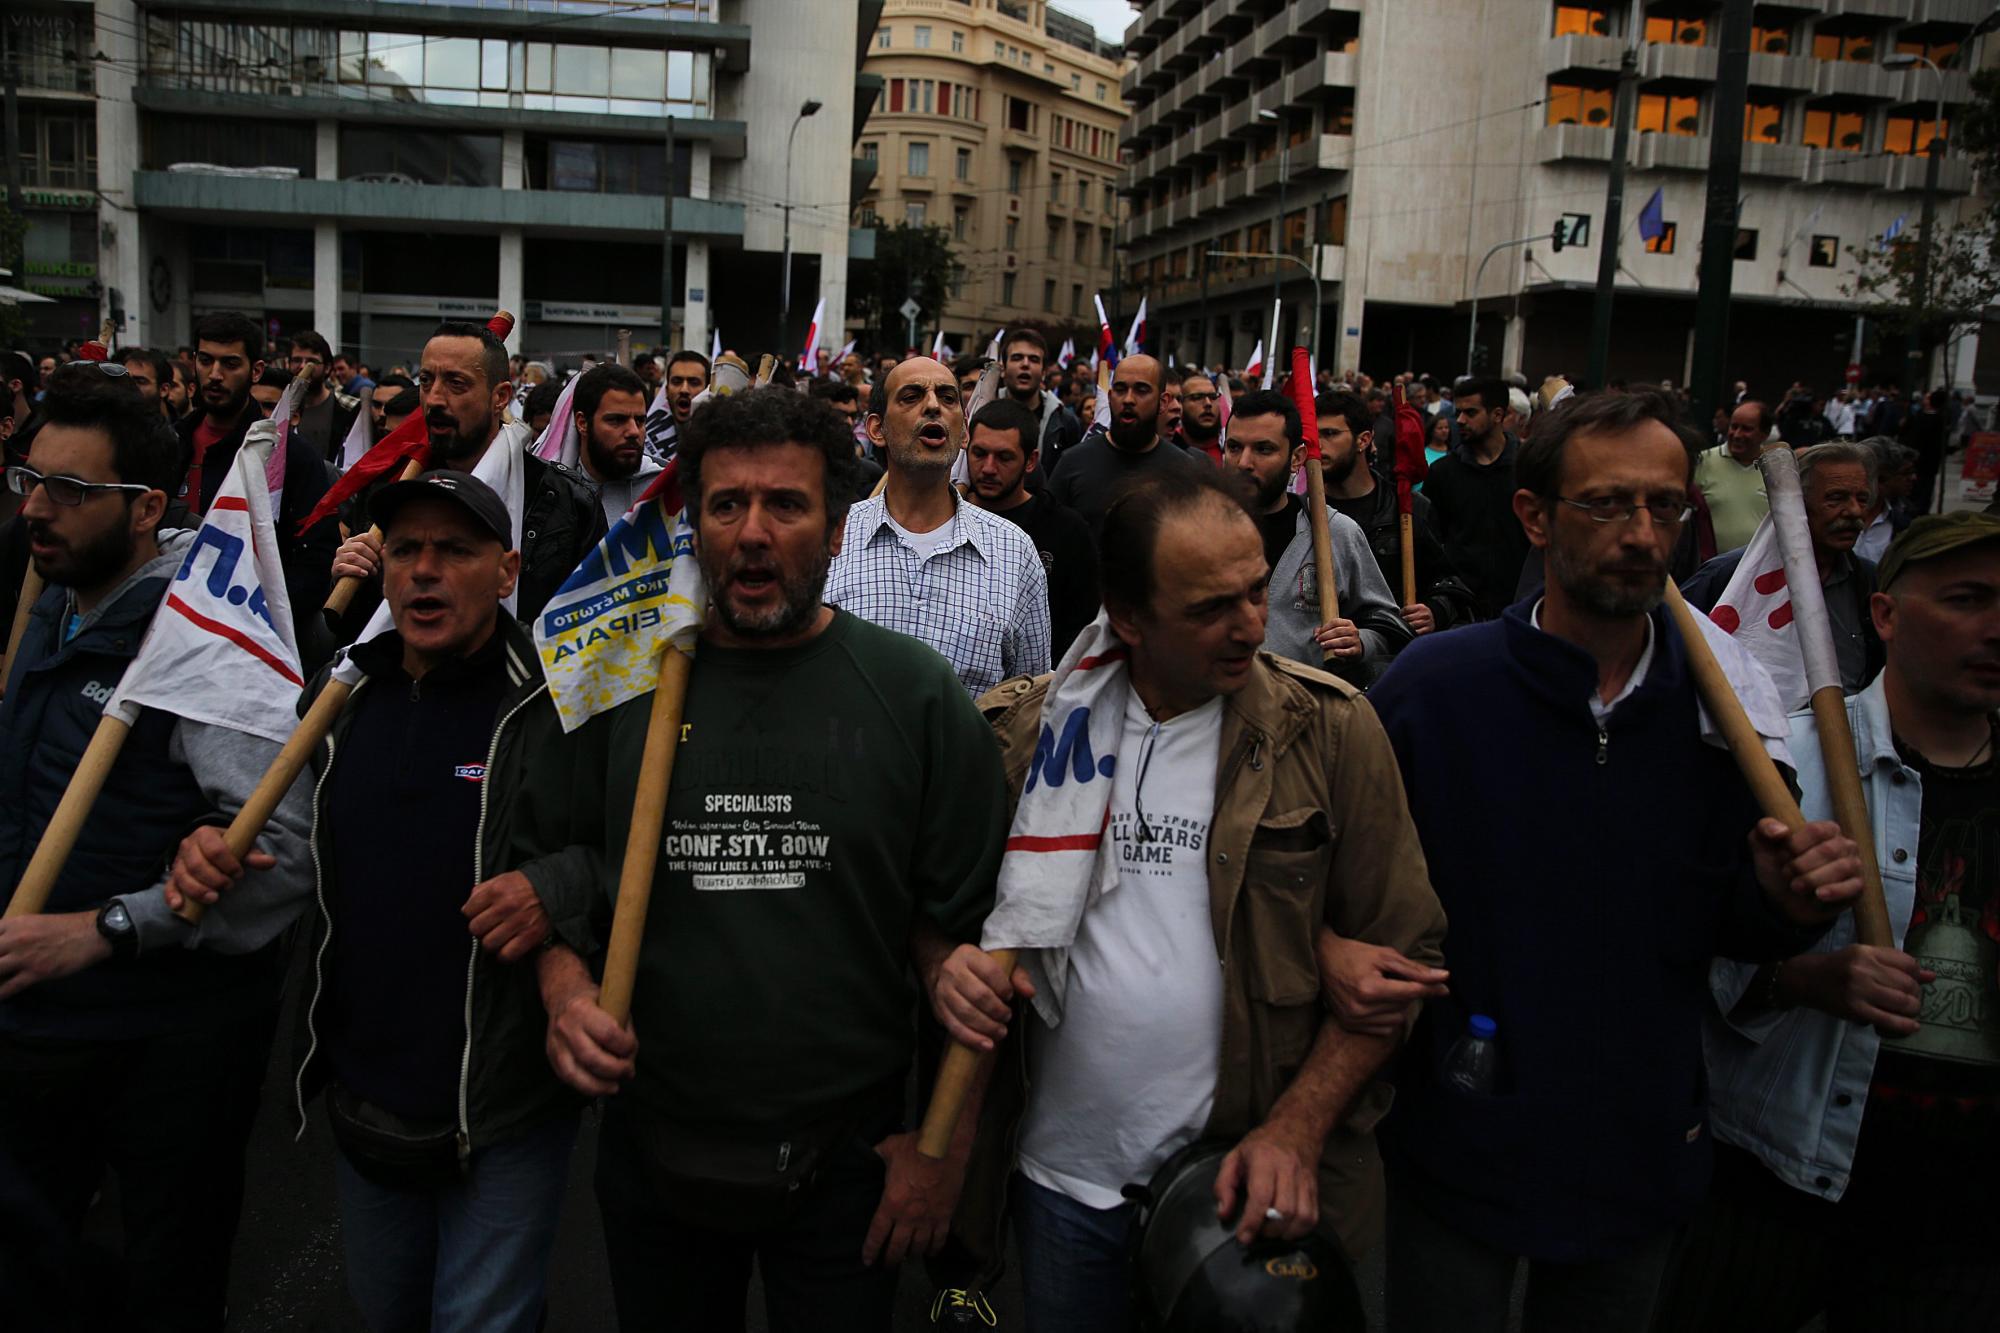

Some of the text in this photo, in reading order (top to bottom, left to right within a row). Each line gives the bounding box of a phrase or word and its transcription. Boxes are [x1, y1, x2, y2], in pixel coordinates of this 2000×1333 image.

[545, 307, 620, 318] NATIONAL BANK
[704, 794, 793, 813] SPECIALISTS
[1123, 844, 1173, 863] GAME
[668, 861, 687, 872] THE
[688, 861, 717, 872] FRONT
[719, 860, 749, 871] LINES
